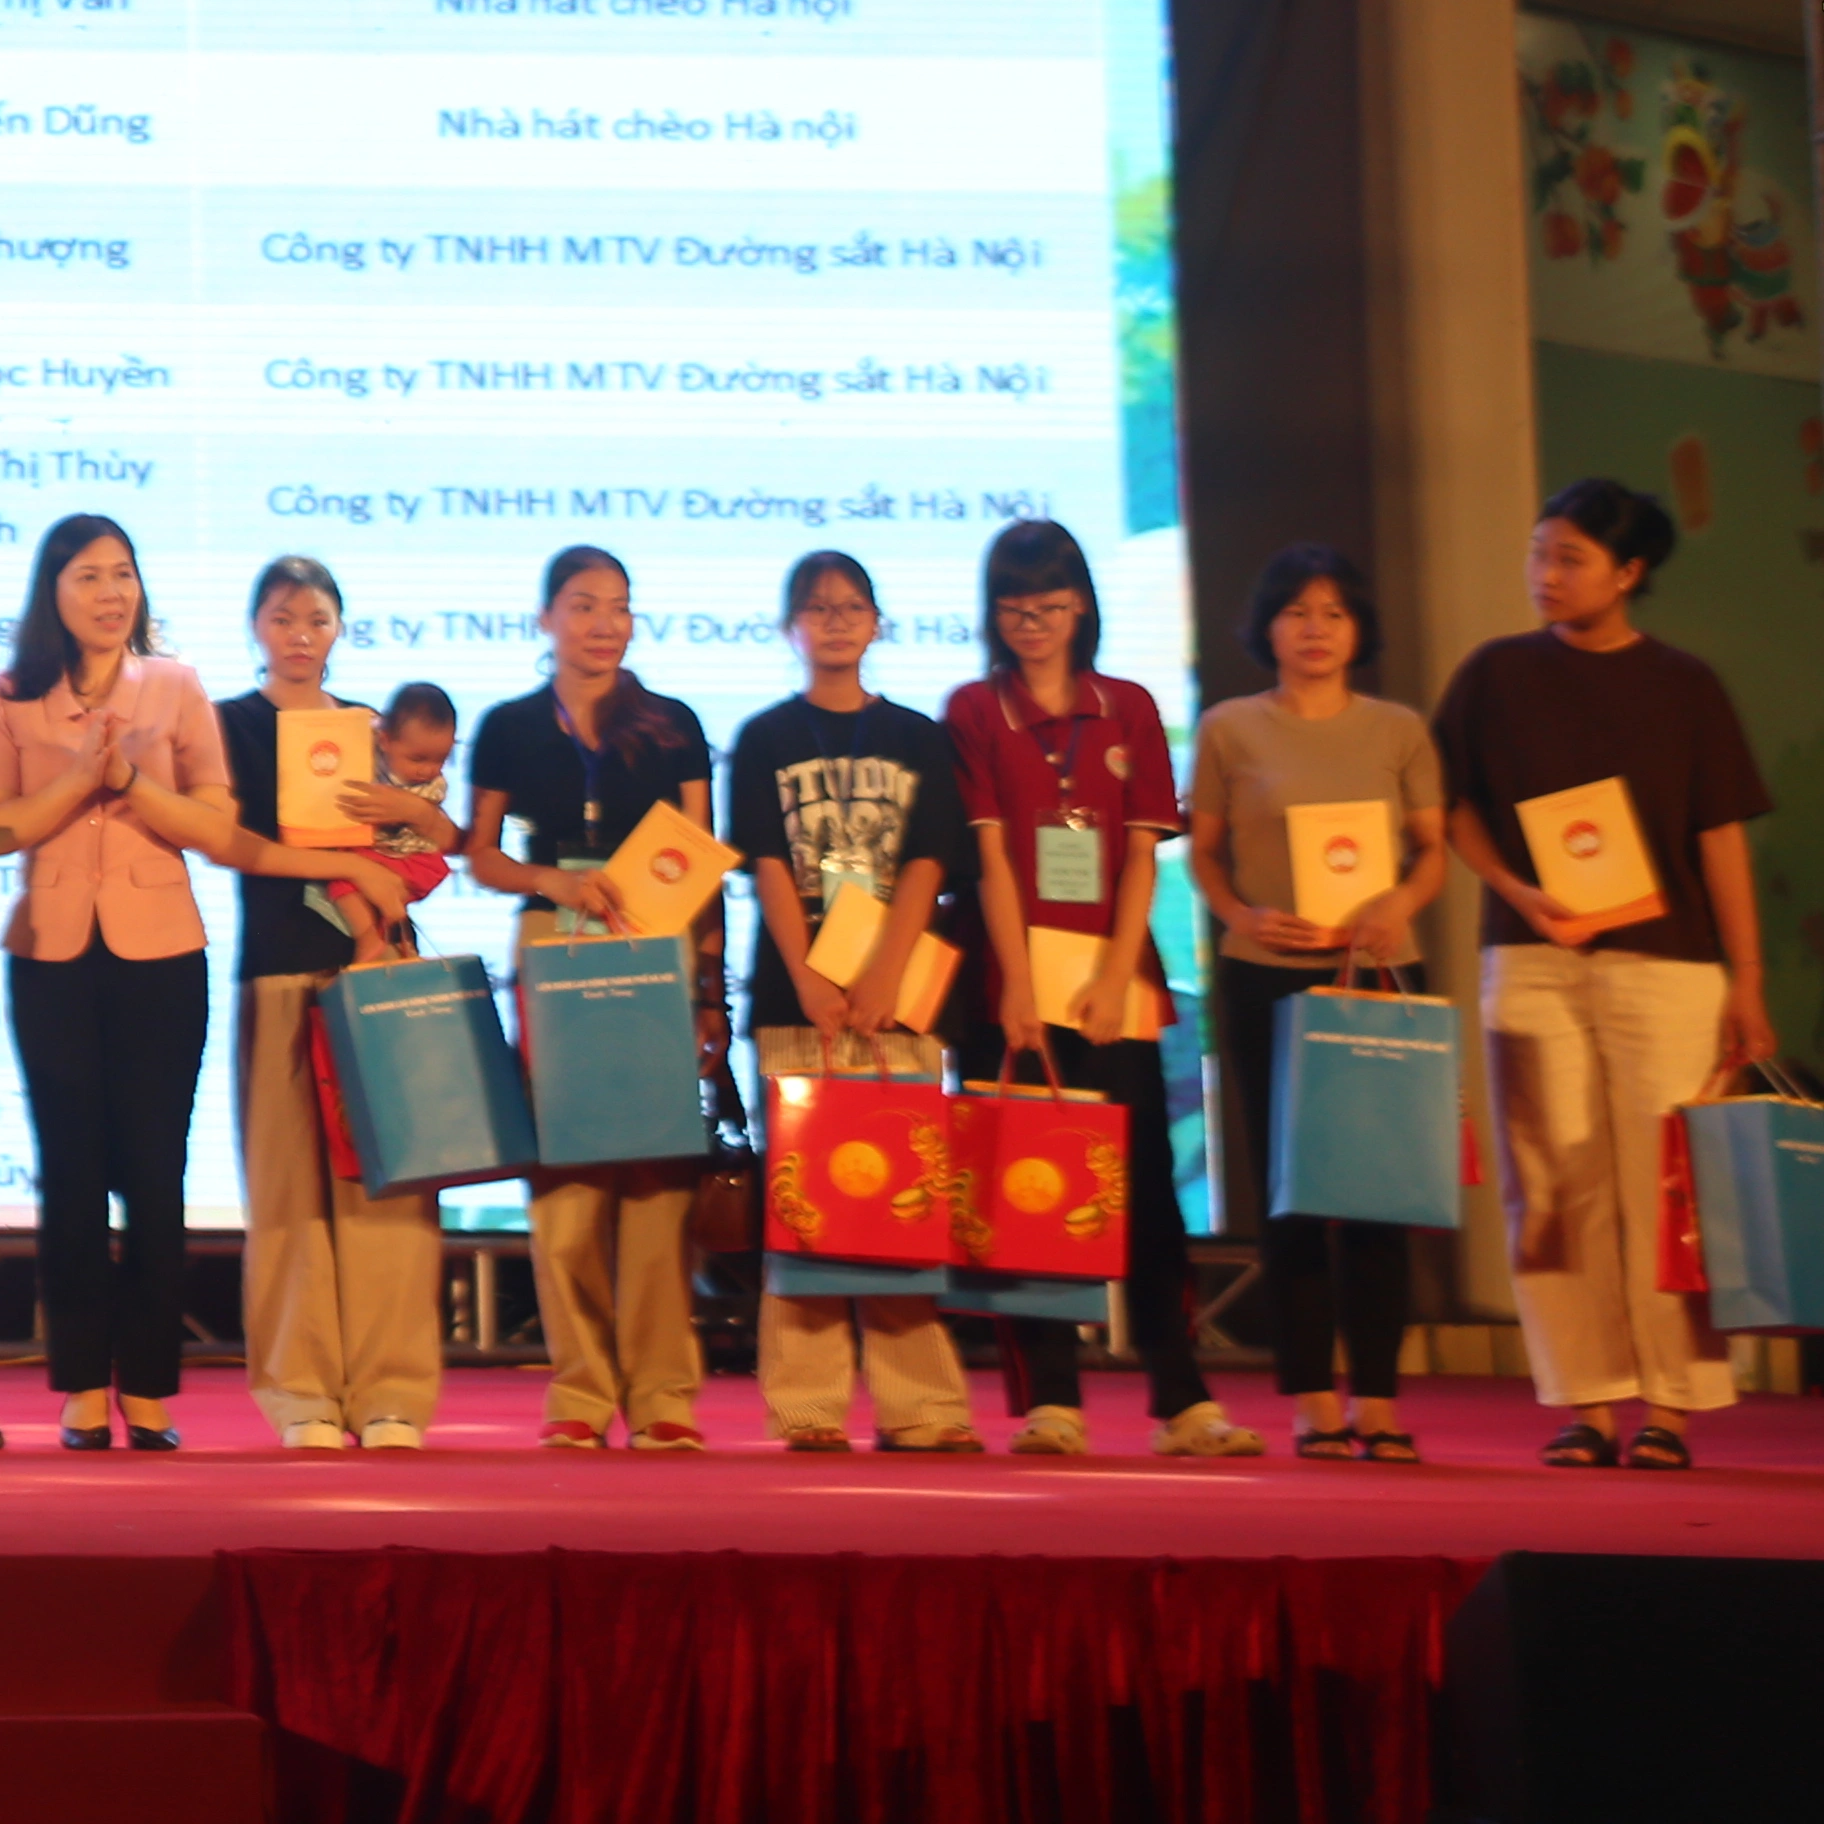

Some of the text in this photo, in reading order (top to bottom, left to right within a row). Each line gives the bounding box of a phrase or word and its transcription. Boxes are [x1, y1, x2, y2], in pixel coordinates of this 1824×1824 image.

[42, 102, 155, 146] Dũng
[260, 230, 369, 274] Công
[377, 237, 417, 271] ty
[427, 232, 551, 265] TNHH
[562, 234, 664, 266] MTV
[672, 234, 821, 277] Đường
[900, 236, 961, 270] Hà
[971, 236, 1044, 276] Nội
[49, 448, 156, 490] Thùy
